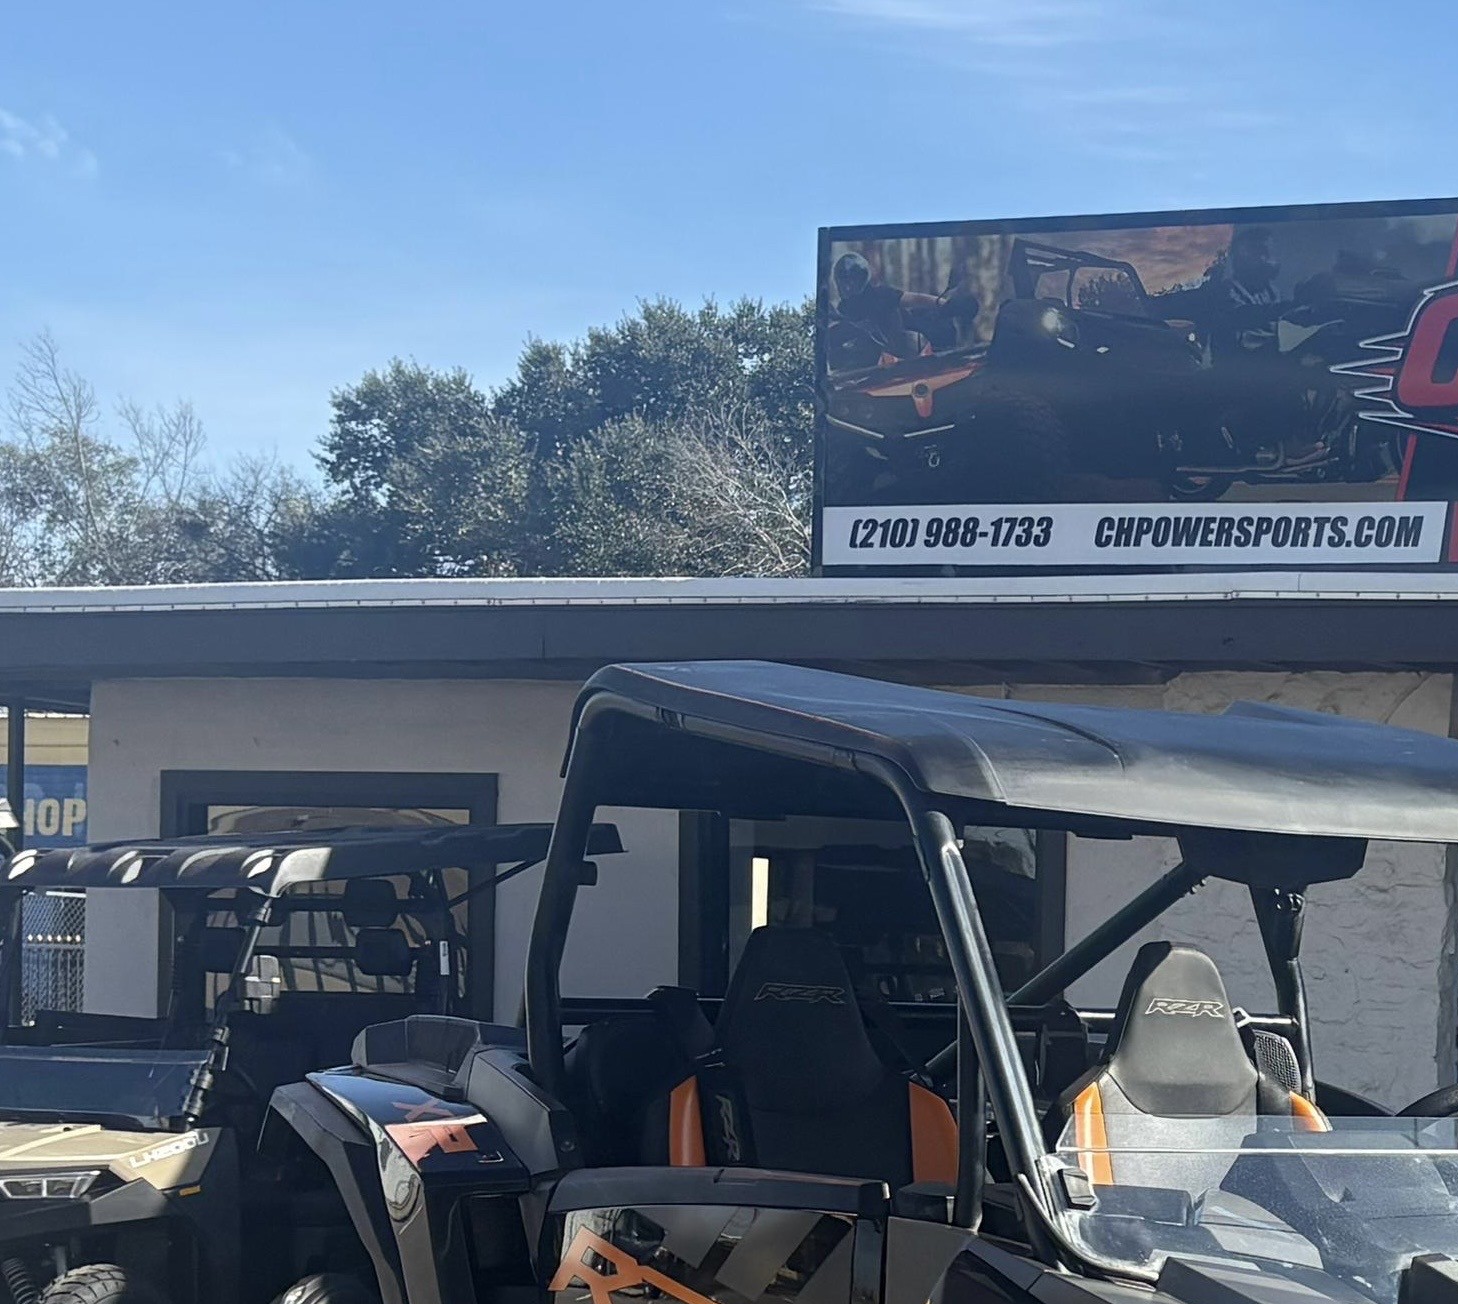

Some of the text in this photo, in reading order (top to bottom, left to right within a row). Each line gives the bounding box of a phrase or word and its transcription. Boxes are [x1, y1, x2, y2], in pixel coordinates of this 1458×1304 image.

[849, 515, 1054, 549] (210) 988-1733
[1094, 514, 1424, 547] CHPOWERSPORTS.COM
[1145, 998, 1225, 1018] RZR
